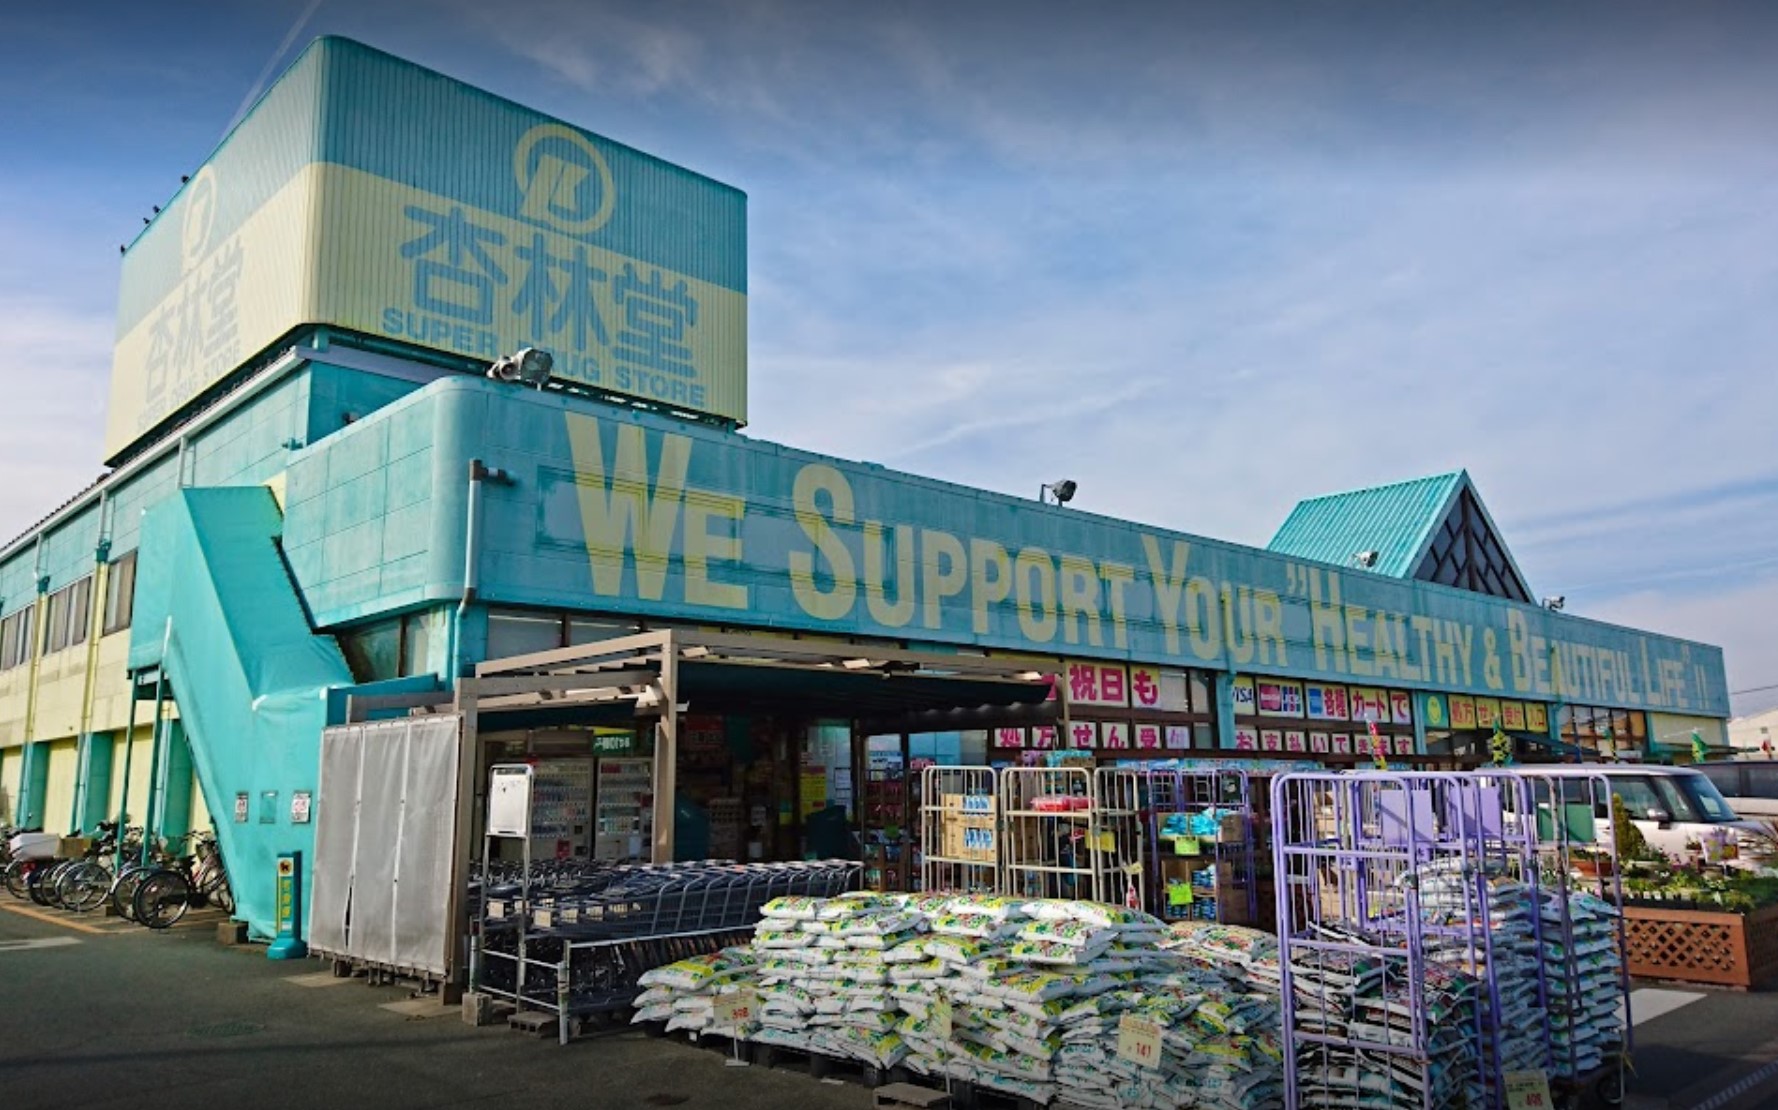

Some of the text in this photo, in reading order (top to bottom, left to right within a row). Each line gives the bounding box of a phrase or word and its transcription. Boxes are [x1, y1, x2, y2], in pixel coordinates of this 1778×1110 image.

[382, 307, 498, 359] SUPER
[616, 367, 706, 407] STORE
[400, 206, 698, 378] 杏林堂
[563, 411, 748, 610] WE
[788, 462, 1134, 650] SUPPORT
[1141, 534, 1288, 667] YOUR
[1483, 627, 1504, 690] &
[1507, 608, 1641, 702] BEAUTIFUL
[1042, 664, 1158, 706] 祝日も
